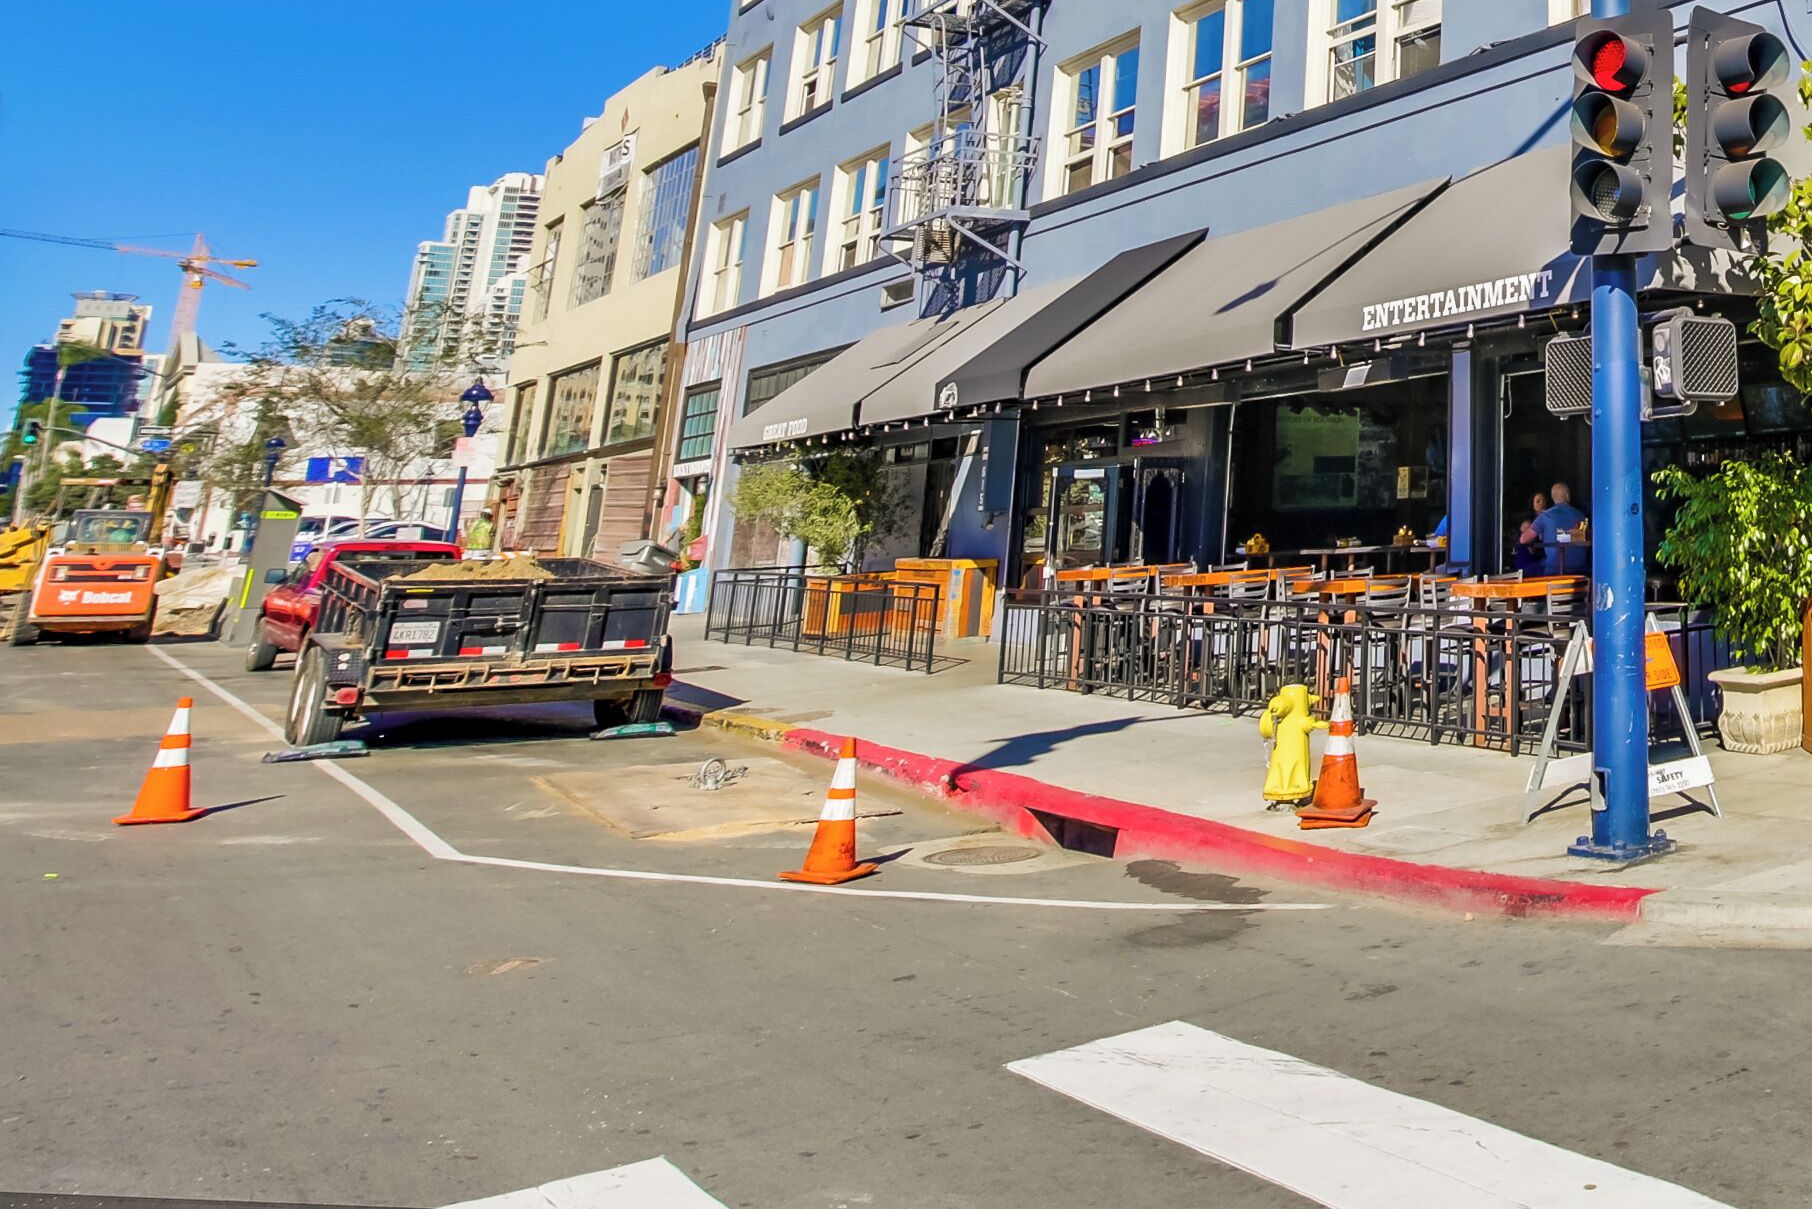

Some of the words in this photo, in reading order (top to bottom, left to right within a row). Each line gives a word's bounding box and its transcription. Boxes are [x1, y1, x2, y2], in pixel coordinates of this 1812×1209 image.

[1362, 270, 1553, 331] ENTERTAINMENT
[328, 459, 348, 478] P
[82, 591, 132, 605] Bobcat
[1656, 771, 1684, 784] SAFETY
